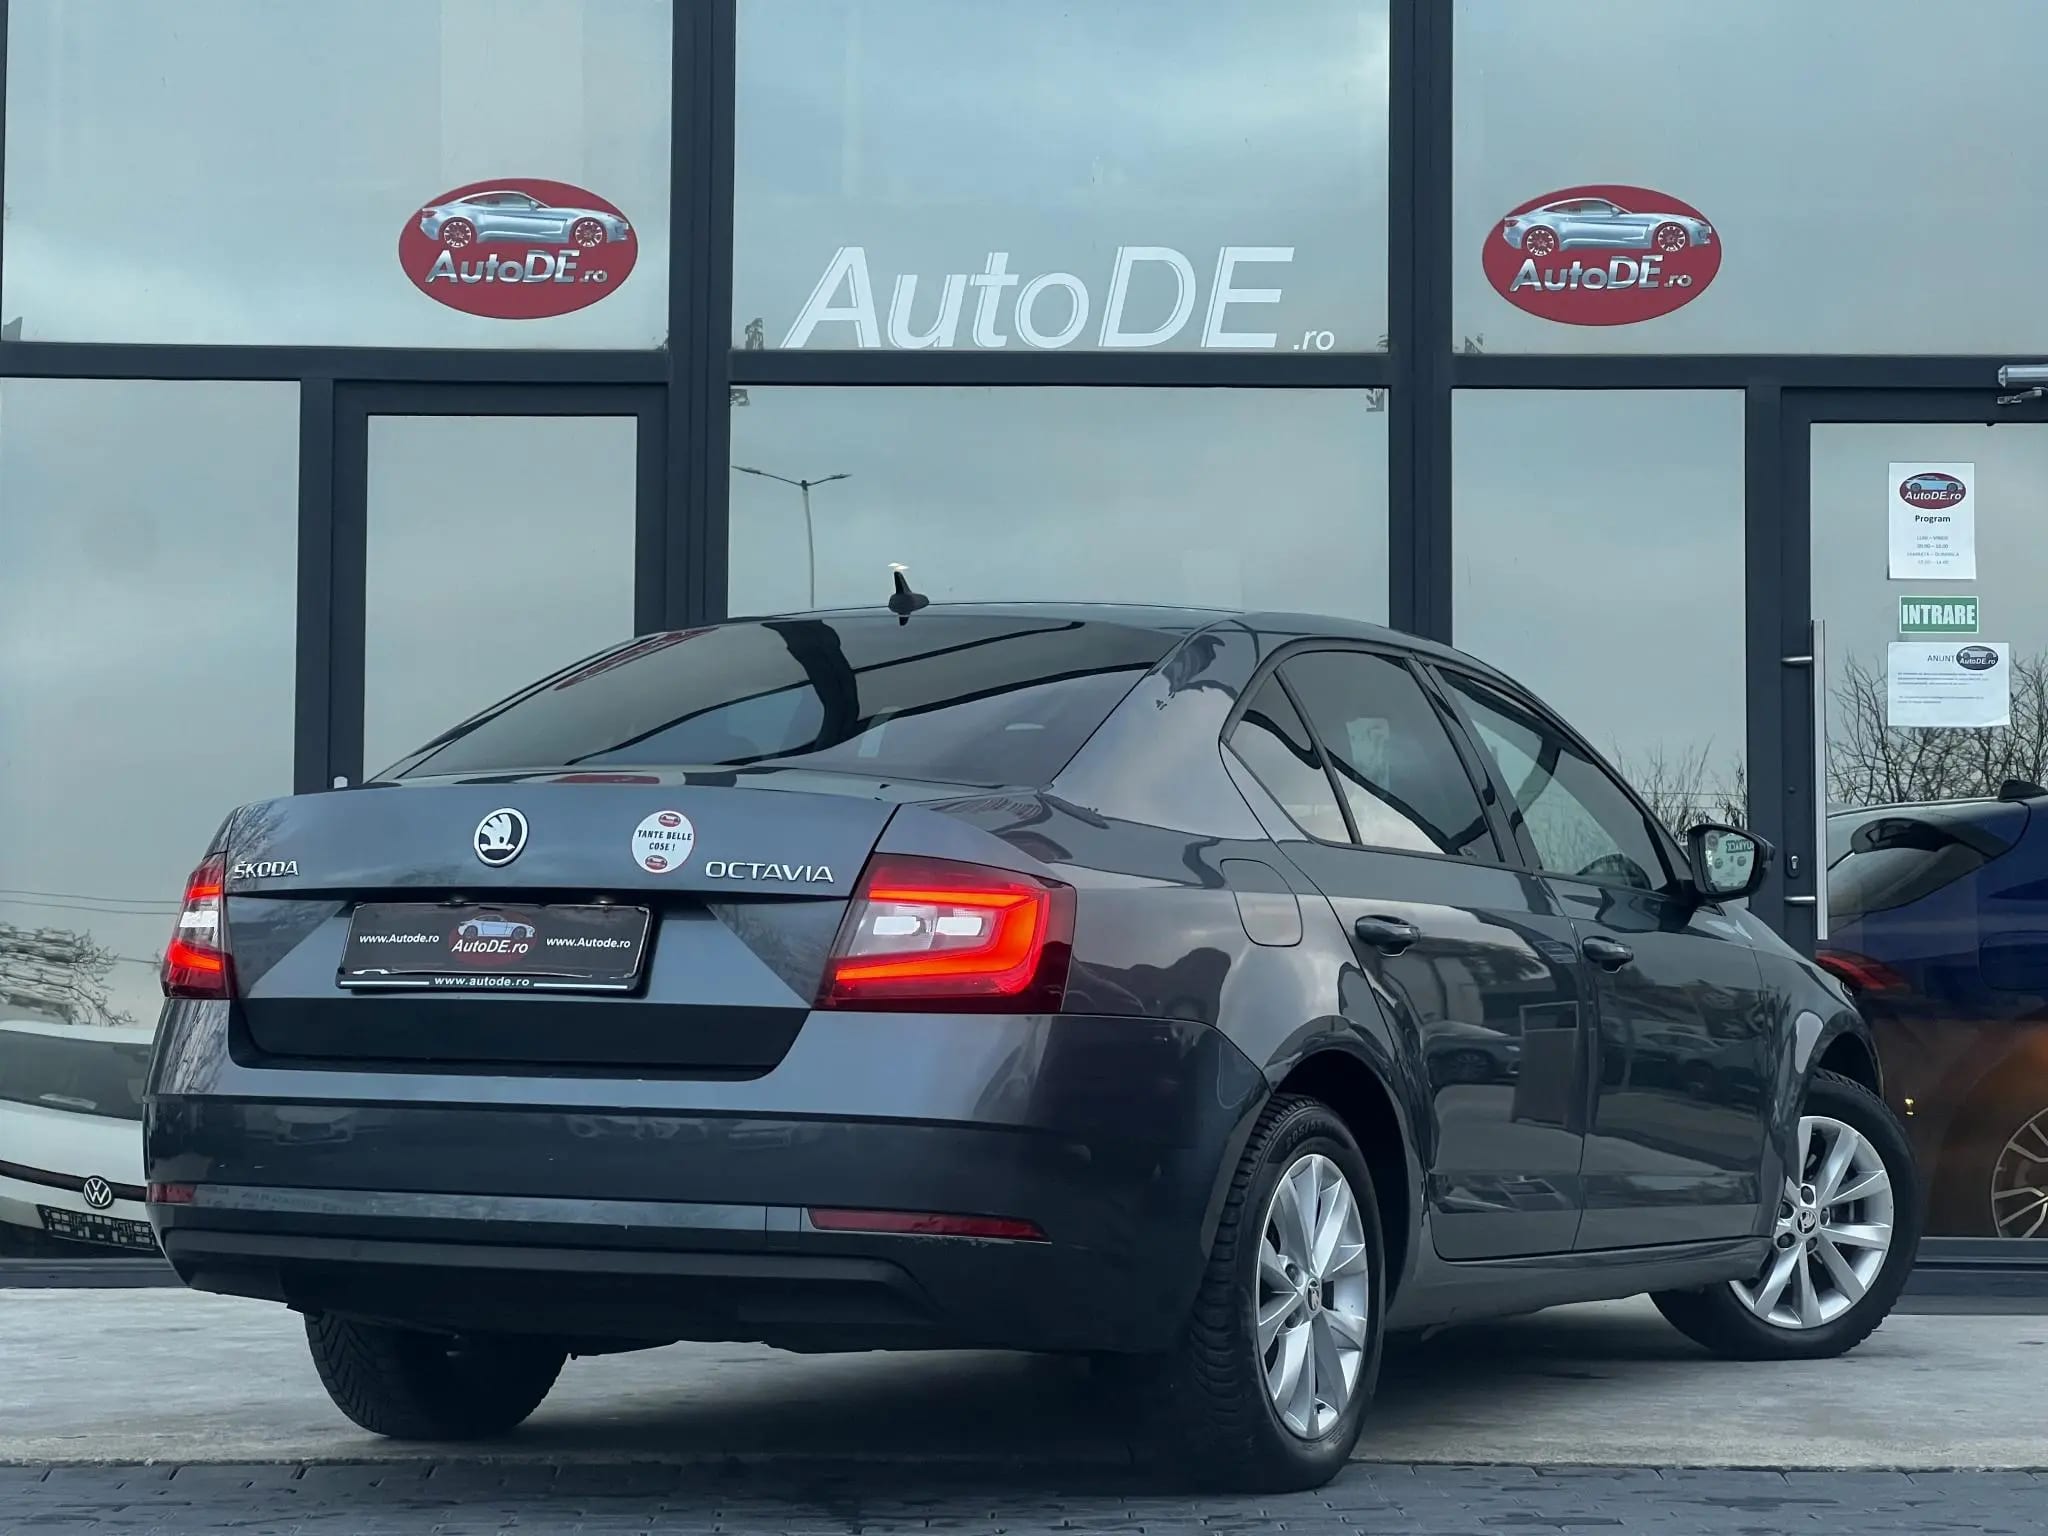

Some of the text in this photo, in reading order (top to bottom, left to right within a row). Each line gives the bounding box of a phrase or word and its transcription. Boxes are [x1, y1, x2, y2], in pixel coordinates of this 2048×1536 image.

[1905, 491, 1962, 500] AutoDE.ro
[1914, 514, 1951, 523] Program
[1902, 604, 1976, 625] INTRARE
[638, 829, 692, 841] TANTE BELLE
[648, 842, 669, 851] COSE
[232, 860, 299, 879] ŠKODA
[705, 861, 835, 883] OCTAVIA
[359, 933, 440, 943] www.Autode.ro
[546, 937, 631, 949] www.Autode.ro
[451, 939, 529, 953] AutoDE.ro
[434, 976, 530, 987] www.autode.ro
